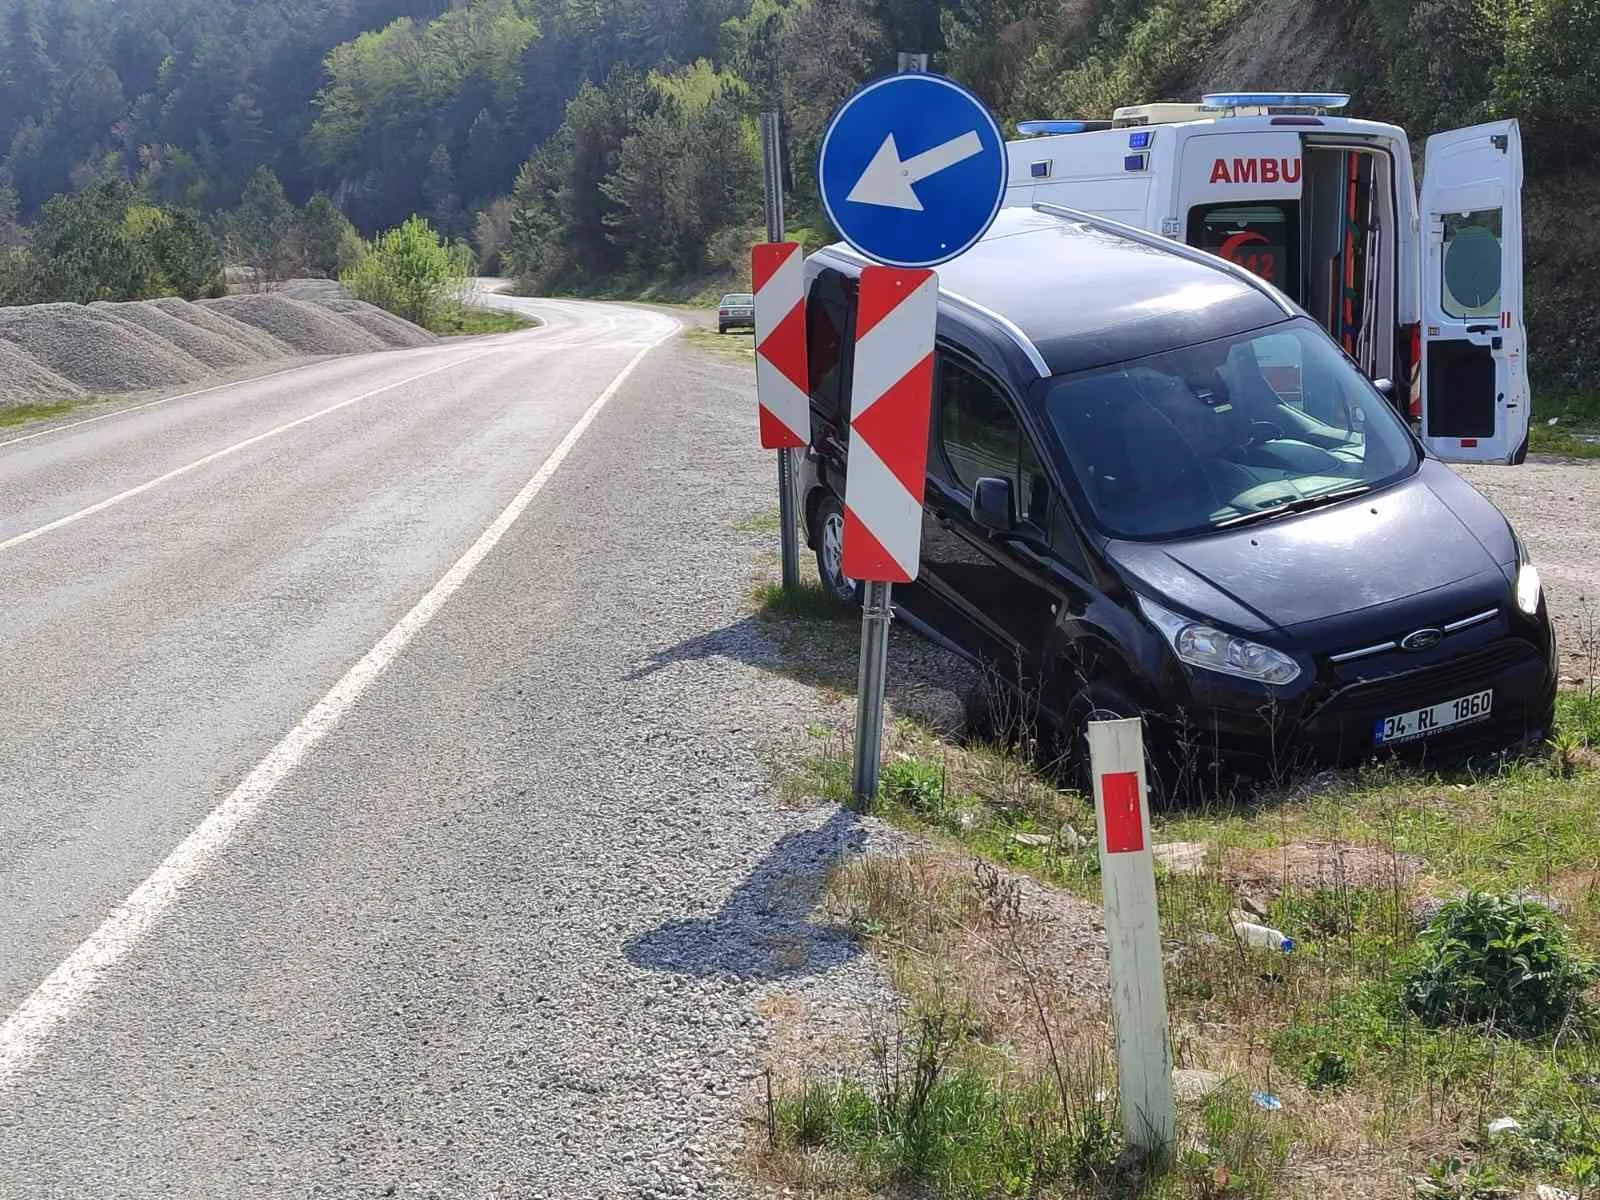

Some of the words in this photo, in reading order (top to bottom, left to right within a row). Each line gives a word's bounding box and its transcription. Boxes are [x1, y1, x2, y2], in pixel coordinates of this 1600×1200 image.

[1209, 158, 1301, 184] AMBU
[1385, 717, 1406, 739] 34
[1418, 708, 1438, 731] RL
[1452, 692, 1491, 721] 1860
